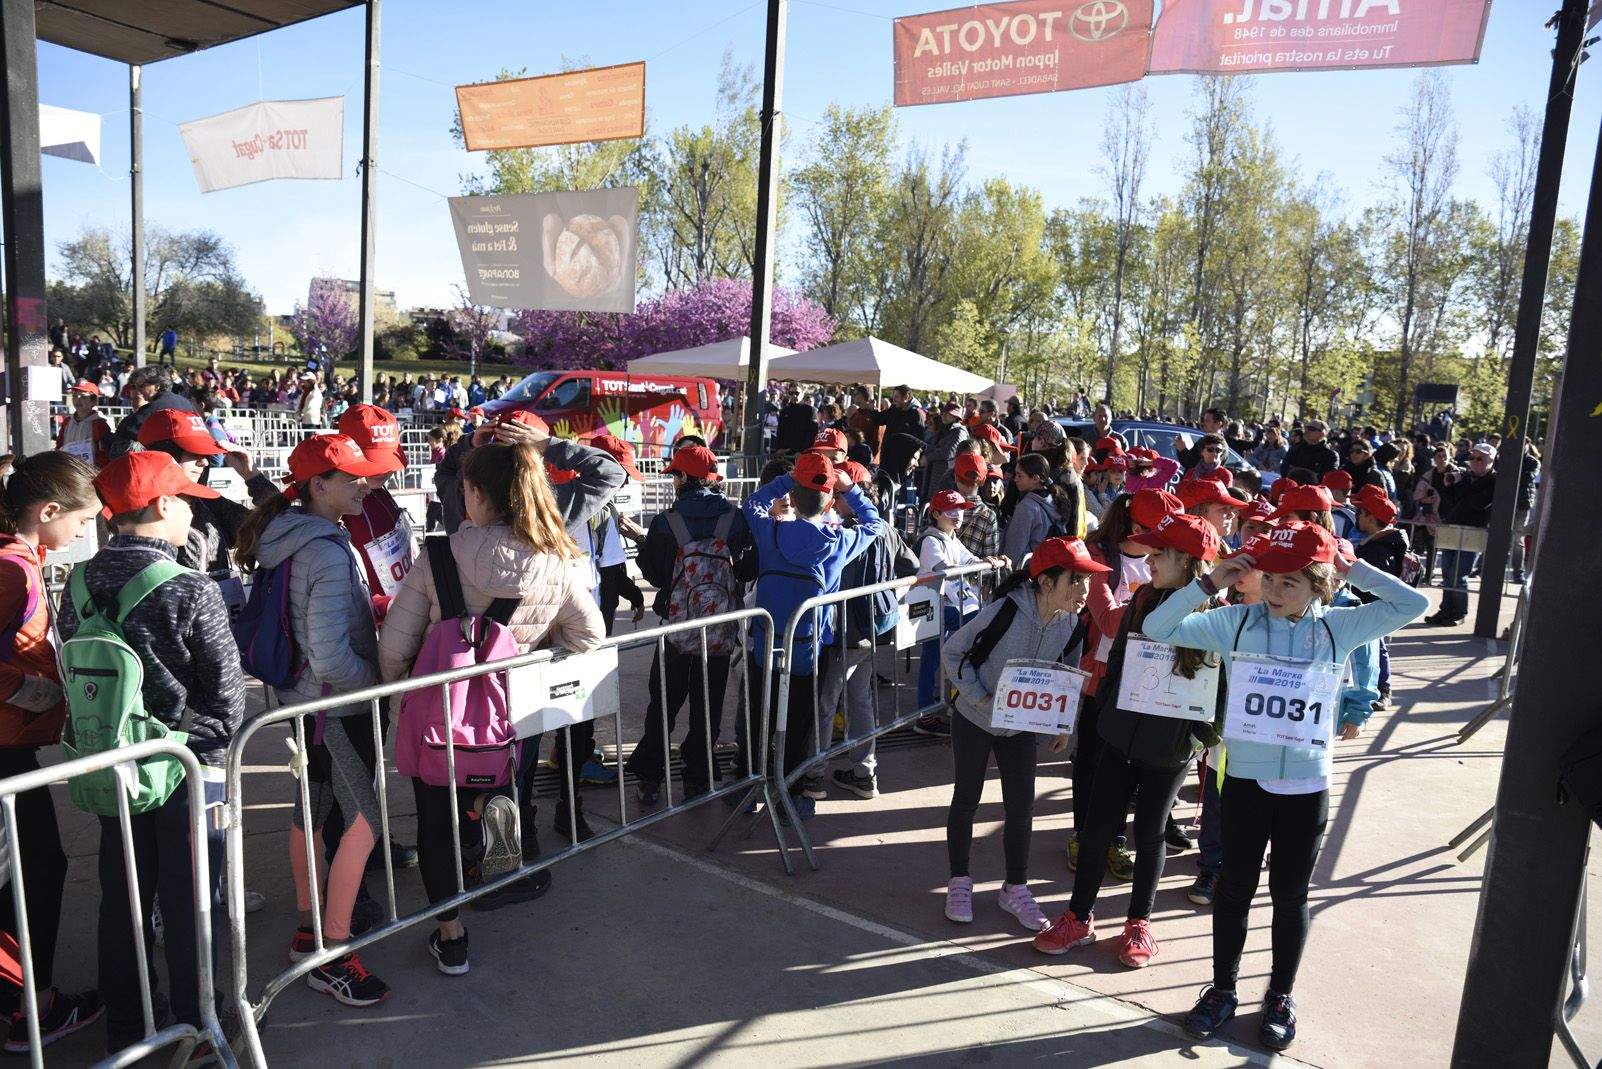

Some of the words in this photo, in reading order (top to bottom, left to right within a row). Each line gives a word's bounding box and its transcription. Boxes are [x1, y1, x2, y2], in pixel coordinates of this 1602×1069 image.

[1272, 529, 1298, 541] TOT
[1029, 670, 1052, 678] Marxa
[1142, 666, 1177, 696] 31
[1272, 668, 1303, 680] Marxa
[1006, 689, 1068, 713] 0031
[1244, 692, 1323, 725] 0031
